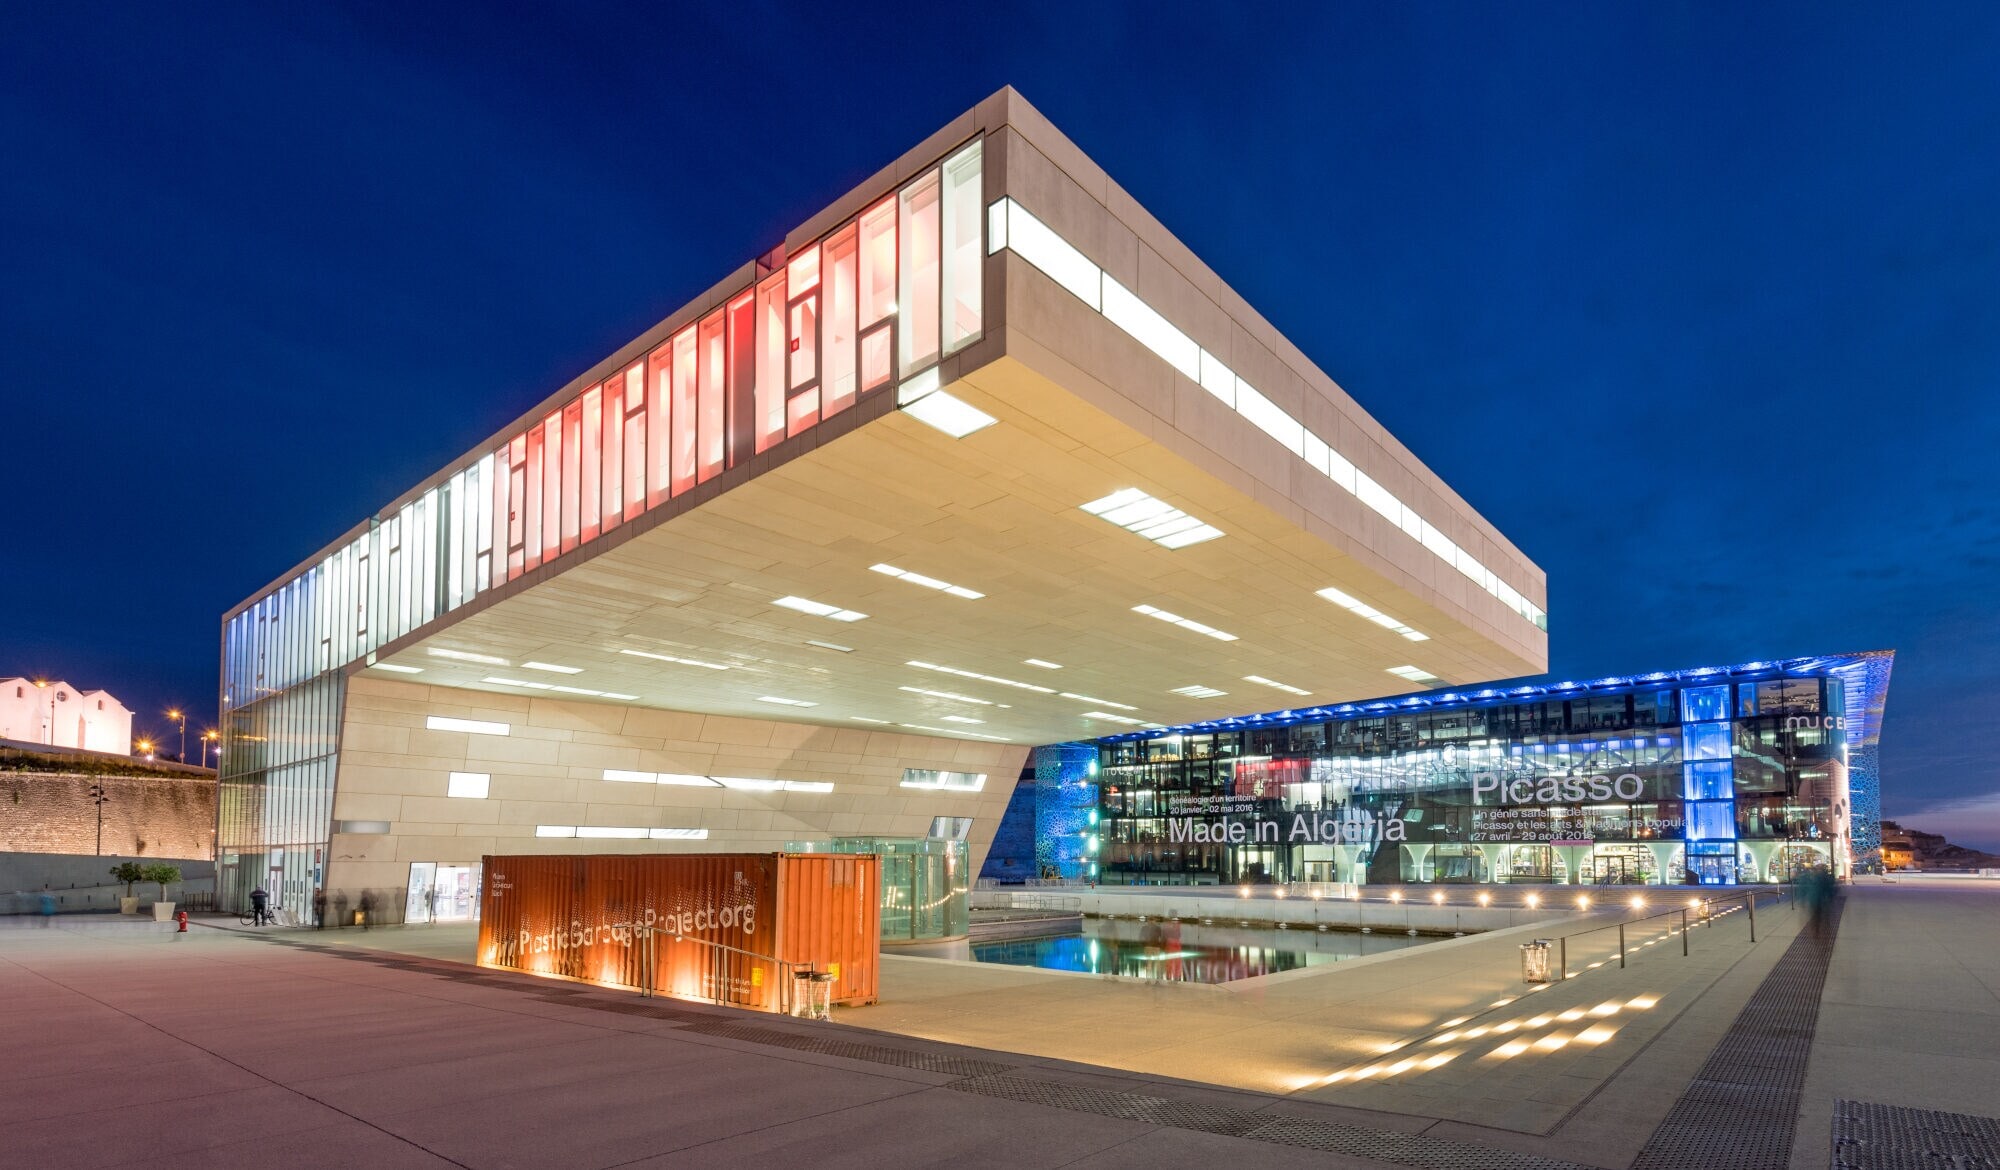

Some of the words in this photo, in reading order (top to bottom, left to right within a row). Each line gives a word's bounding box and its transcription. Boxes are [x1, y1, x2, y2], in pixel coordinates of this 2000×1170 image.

[1472, 771, 1644, 804] Picasso
[1225, 793, 1257, 802] territoire
[1180, 806, 1202, 815] janvier
[1235, 804, 1254, 812] 2016
[1490, 808, 1519, 820] génie
[1521, 809, 1547, 818] sans
[1169, 816, 1246, 843] Made
[1255, 816, 1279, 842] in
[1288, 812, 1408, 846] Algeria
[1473, 820, 1514, 830] Picasso
[1516, 820, 1529, 829] et
[1530, 820, 1547, 829] les
[1575, 819, 1584, 829] &
[1474, 832, 1487, 841] 27
[1489, 832, 1511, 841] avril
[1521, 831, 1537, 841] 29
[1566, 831, 1595, 840] 2016
